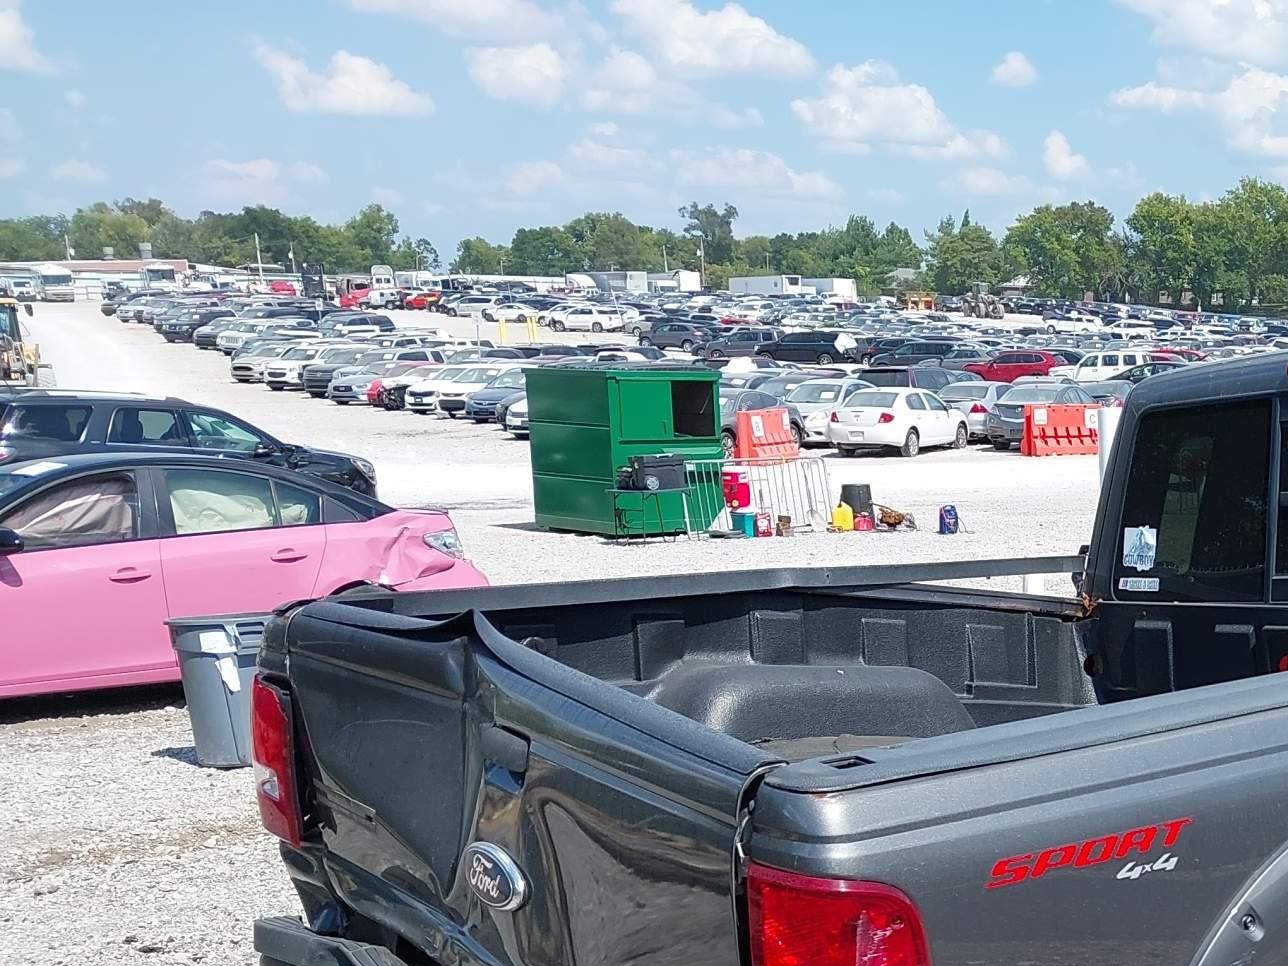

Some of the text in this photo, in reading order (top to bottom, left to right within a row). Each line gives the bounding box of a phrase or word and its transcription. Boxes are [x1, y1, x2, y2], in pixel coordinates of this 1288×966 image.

[470, 853, 501, 899] Ford
[984, 816, 1195, 890] SPORT
[1115, 853, 1179, 881] 4x4
